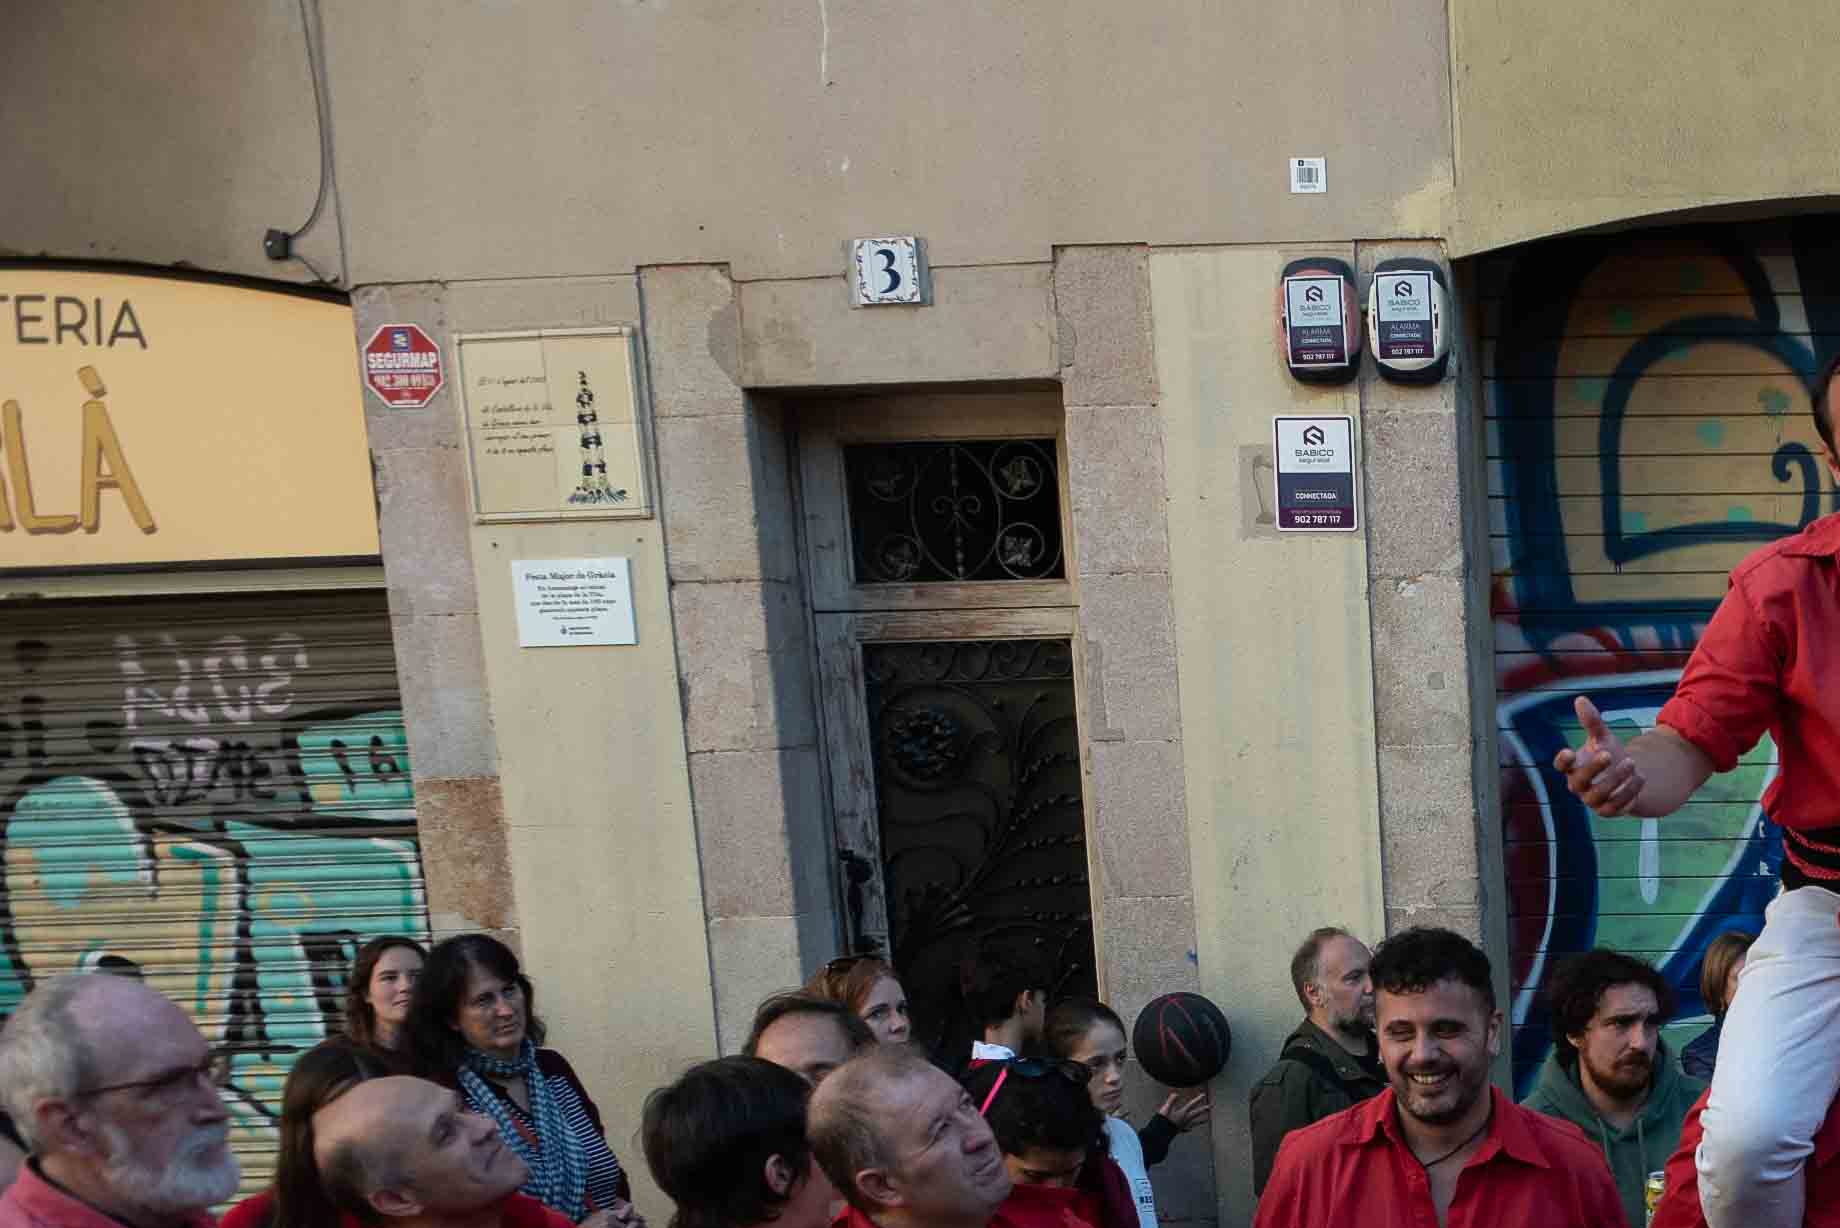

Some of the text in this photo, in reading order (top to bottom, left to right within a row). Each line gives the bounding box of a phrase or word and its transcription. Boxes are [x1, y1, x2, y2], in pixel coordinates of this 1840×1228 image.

[874, 249, 901, 293] 3
[0, 294, 148, 350] ERIA
[368, 352, 437, 369] SEGURMAP
[0, 365, 158, 535] LÀ
[1295, 449, 1335, 457] SABICO
[1295, 492, 1337, 500] CONNECTADA
[1294, 515, 1341, 524] 902 787 117
